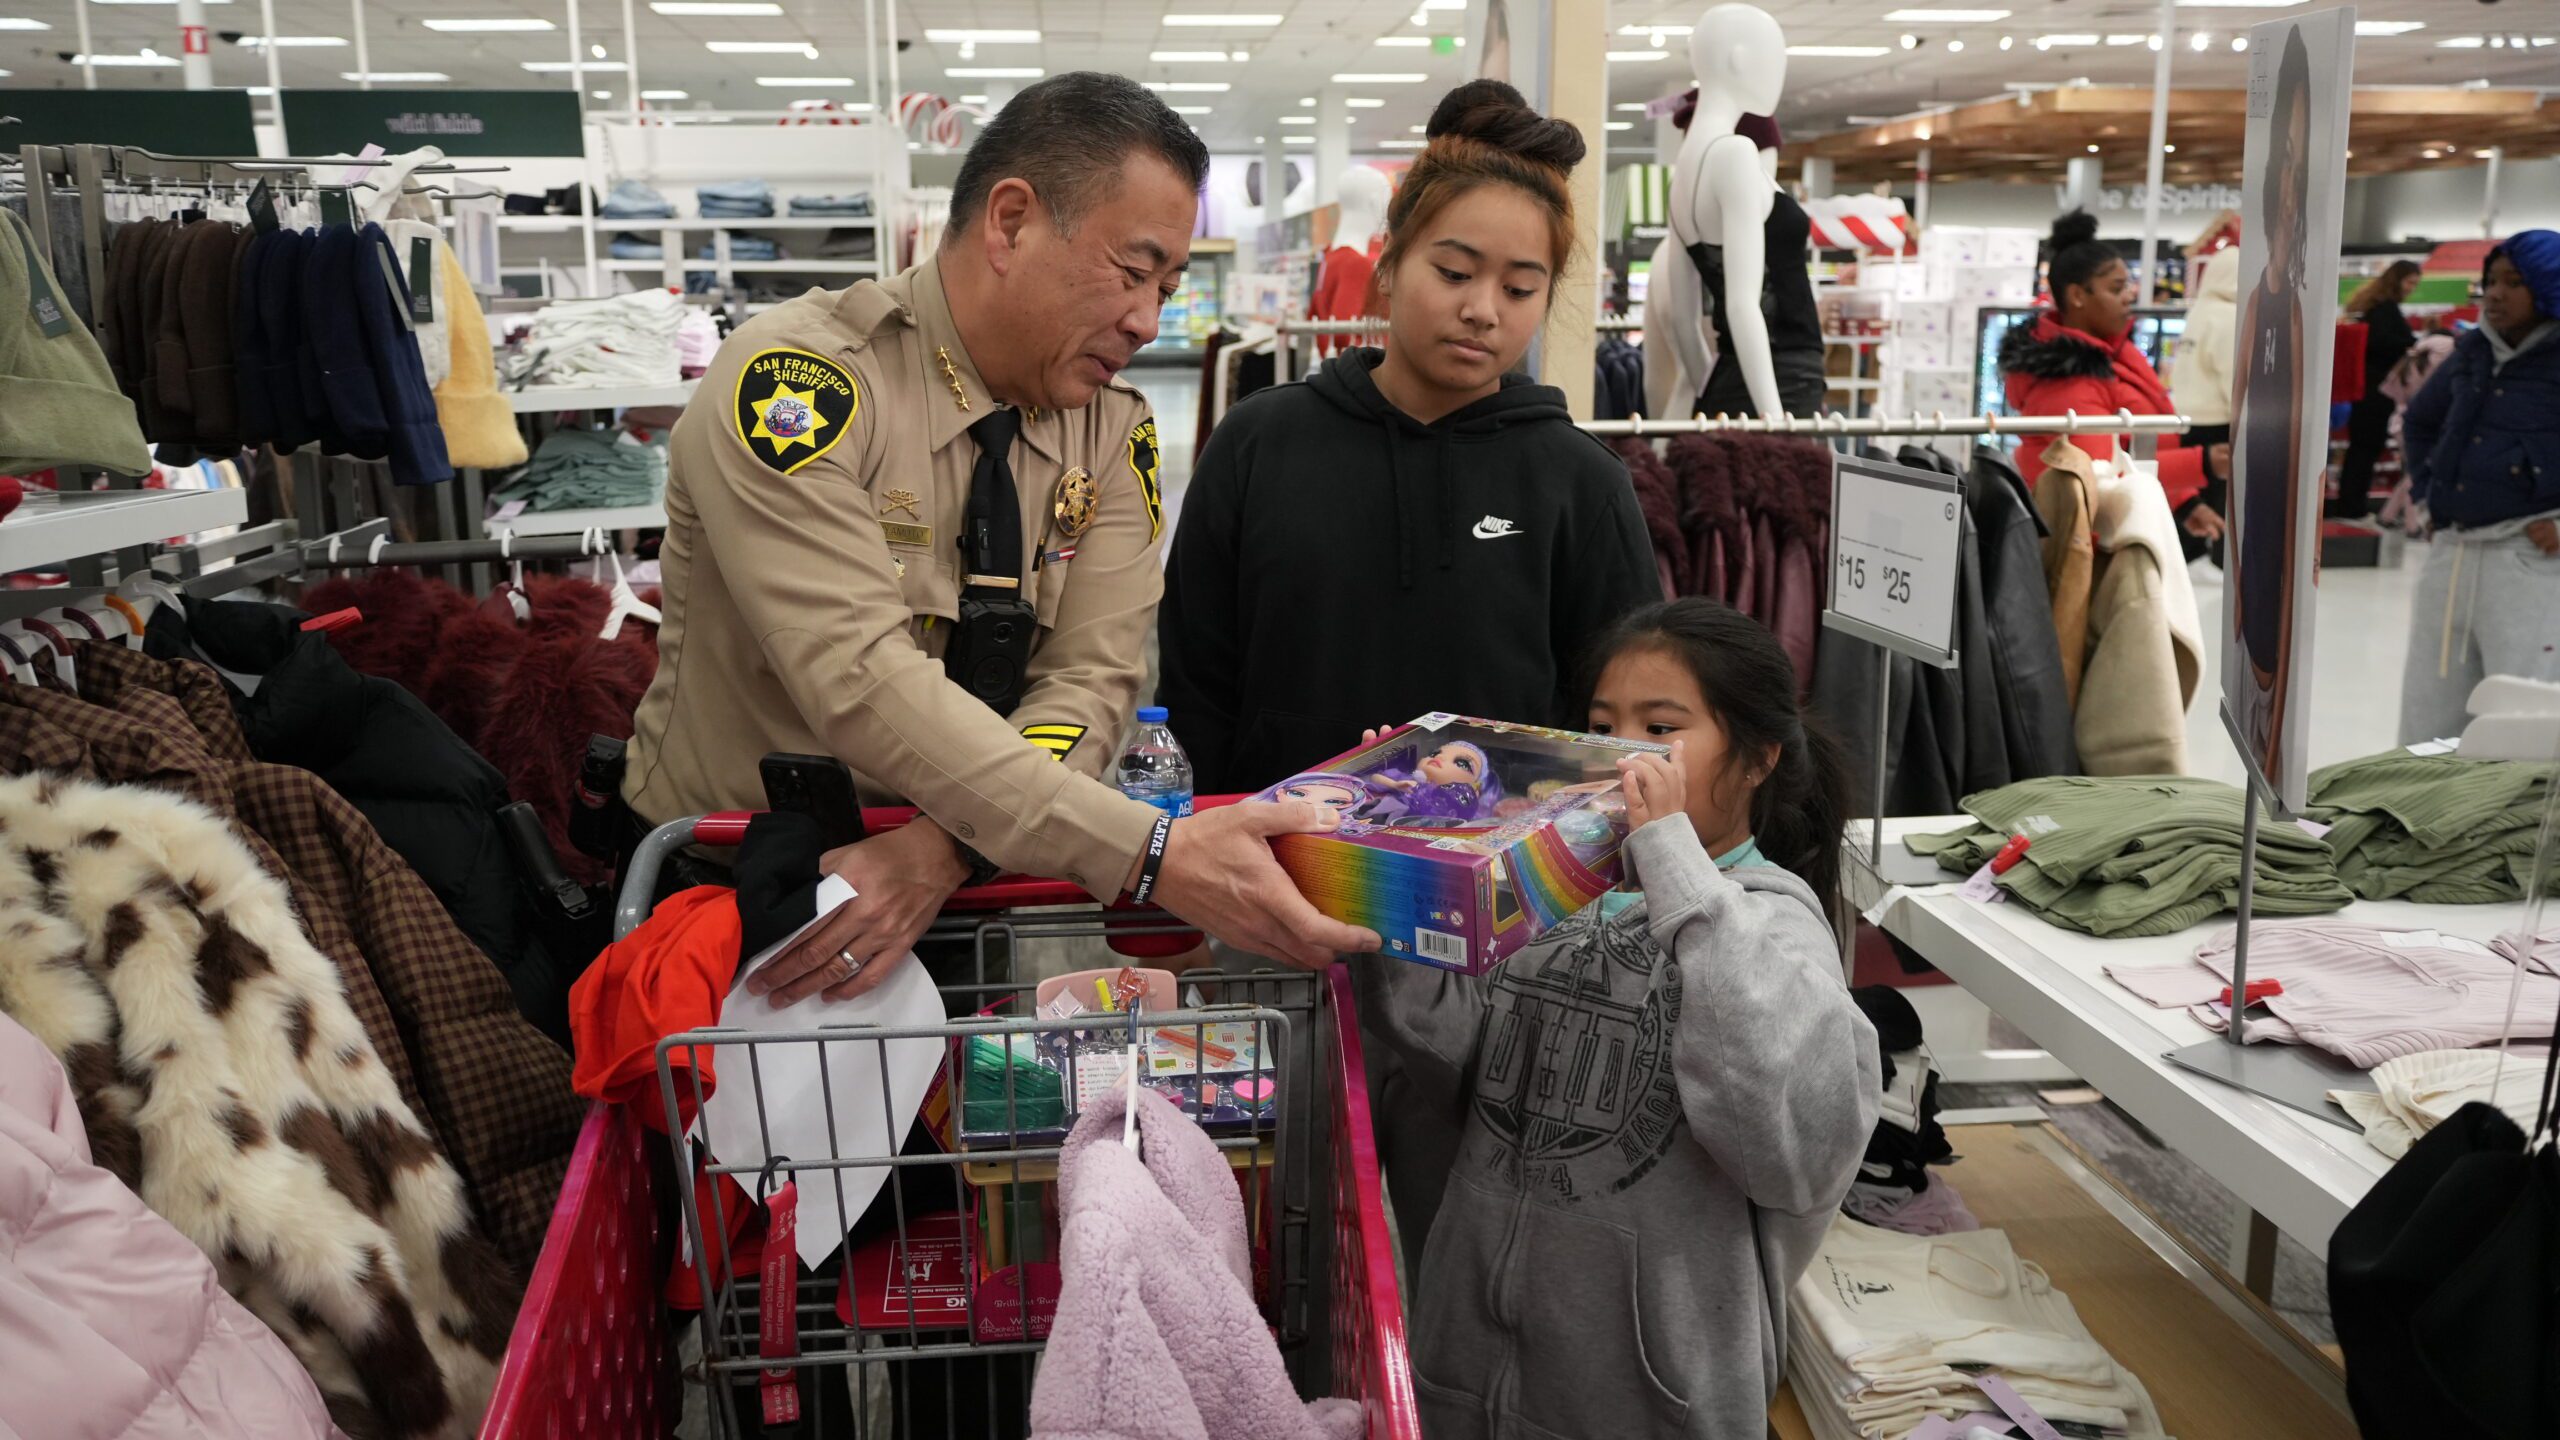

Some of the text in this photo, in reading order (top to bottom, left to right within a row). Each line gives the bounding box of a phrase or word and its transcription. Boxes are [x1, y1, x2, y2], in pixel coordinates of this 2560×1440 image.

[2054, 183, 2123, 210] Wne
[754, 358, 851, 396] SAN FRANCISCO
[773, 369, 829, 391] SHERIFF
[1480, 514, 1514, 533] NIKE
[1838, 553, 1911, 604] $15 $25
[1177, 799, 1194, 818] AQU
[1149, 815, 1170, 857] PLAYAZ
[994, 1296, 1058, 1308] Brillint Bur
[1010, 1315, 1055, 1325] WRNIN
